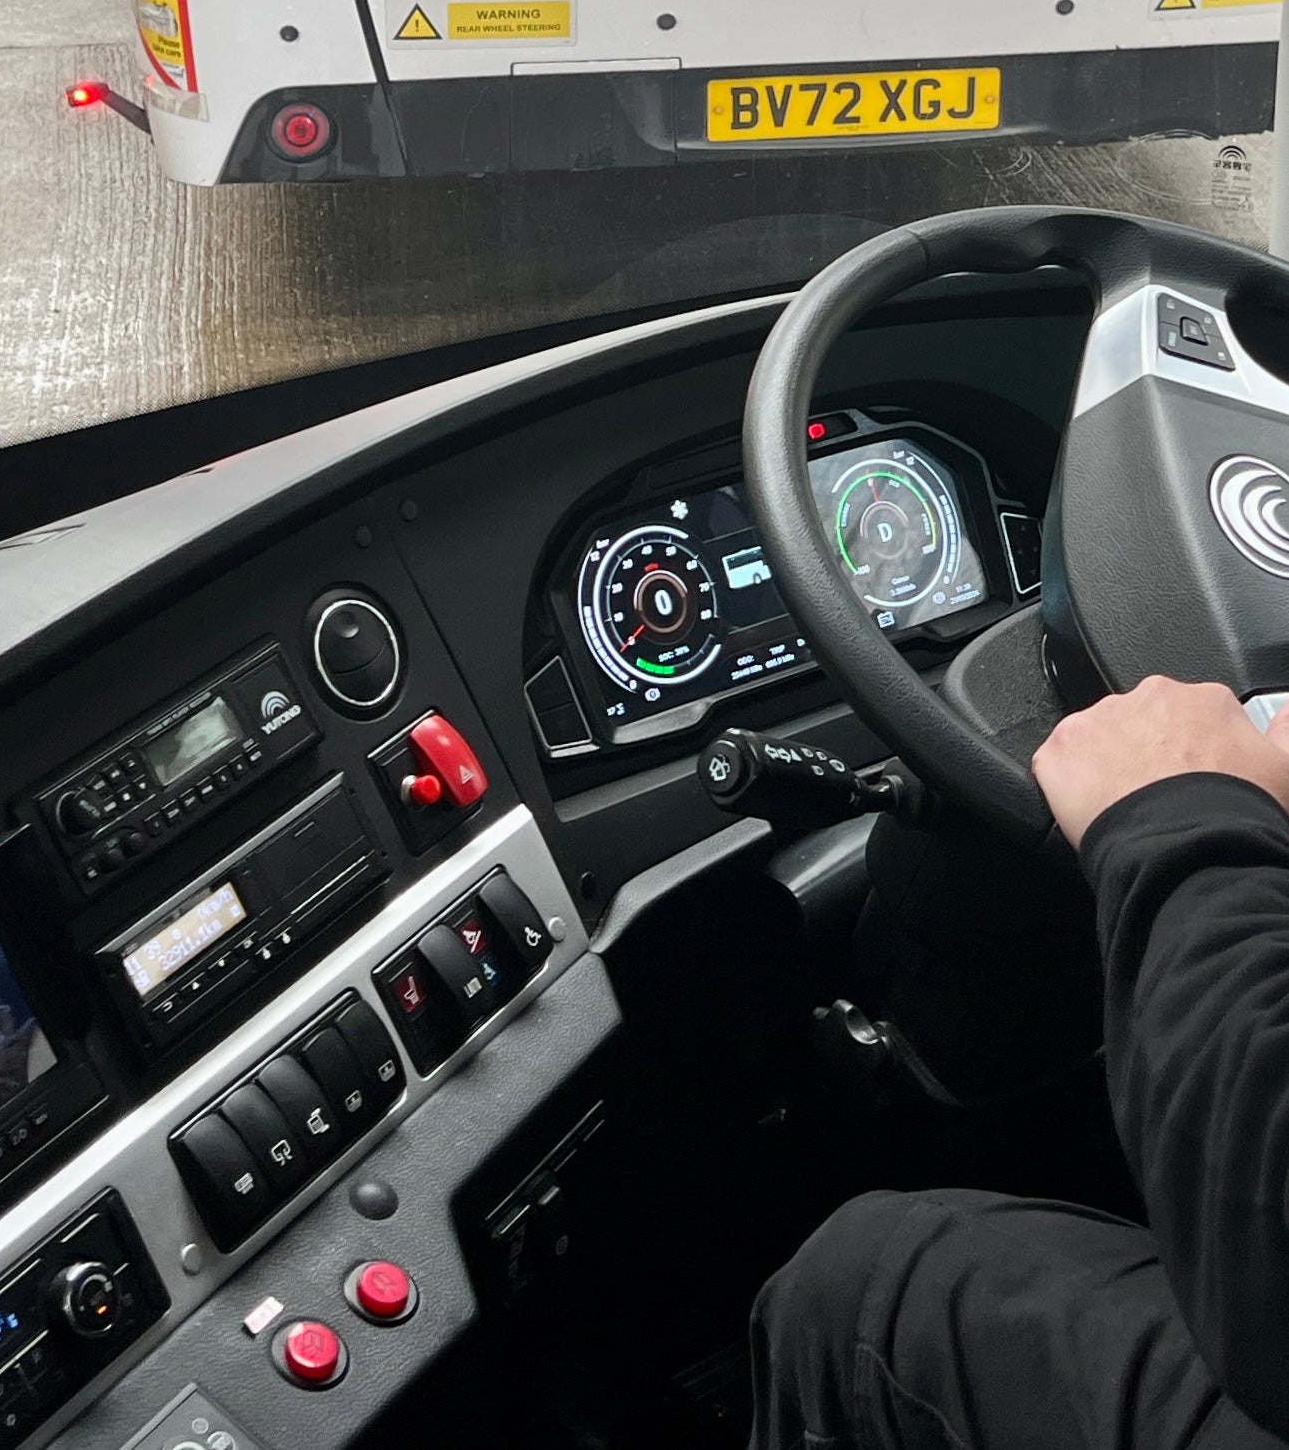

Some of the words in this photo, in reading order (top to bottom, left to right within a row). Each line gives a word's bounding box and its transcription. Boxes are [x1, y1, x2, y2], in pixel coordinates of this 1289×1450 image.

[476, 9, 541, 20] WARNING
[456, 25, 481, 33] REAR
[483, 24, 514, 32] WHEEL
[517, 23, 561, 32] STEERING
[730, 82, 861, 130] BV72
[879, 77, 976, 122] XGJ
[877, 523, 893, 543] D
[654, 589, 674, 616] 0
[260, 704, 302, 735] YUTONG
